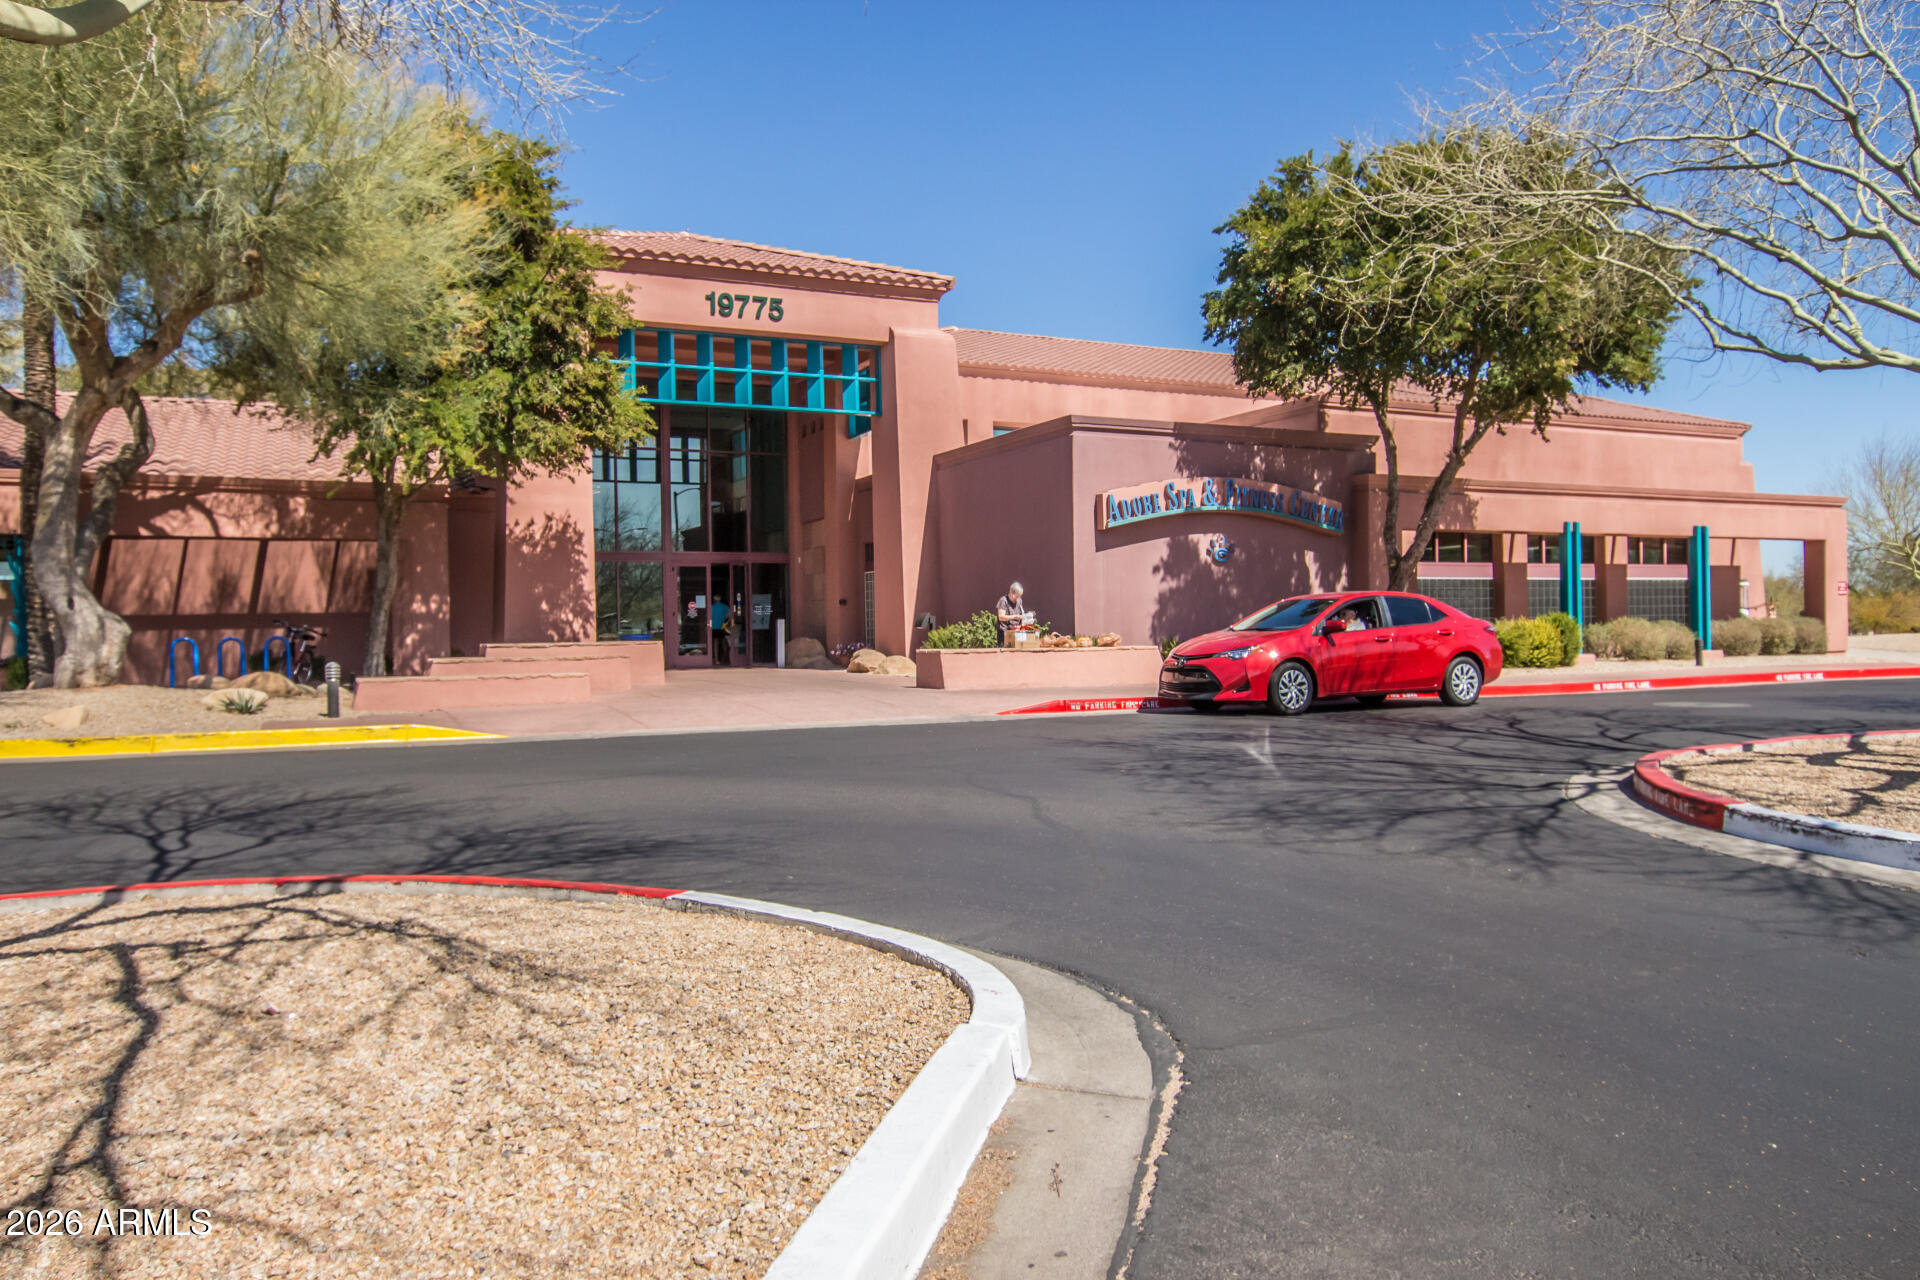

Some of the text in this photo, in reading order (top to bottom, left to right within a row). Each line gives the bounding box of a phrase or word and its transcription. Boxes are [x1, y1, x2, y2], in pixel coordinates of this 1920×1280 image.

[705, 291, 784, 322] 19775
[1203, 477, 1218, 507] &
[1084, 701, 1117, 710] PARKING
